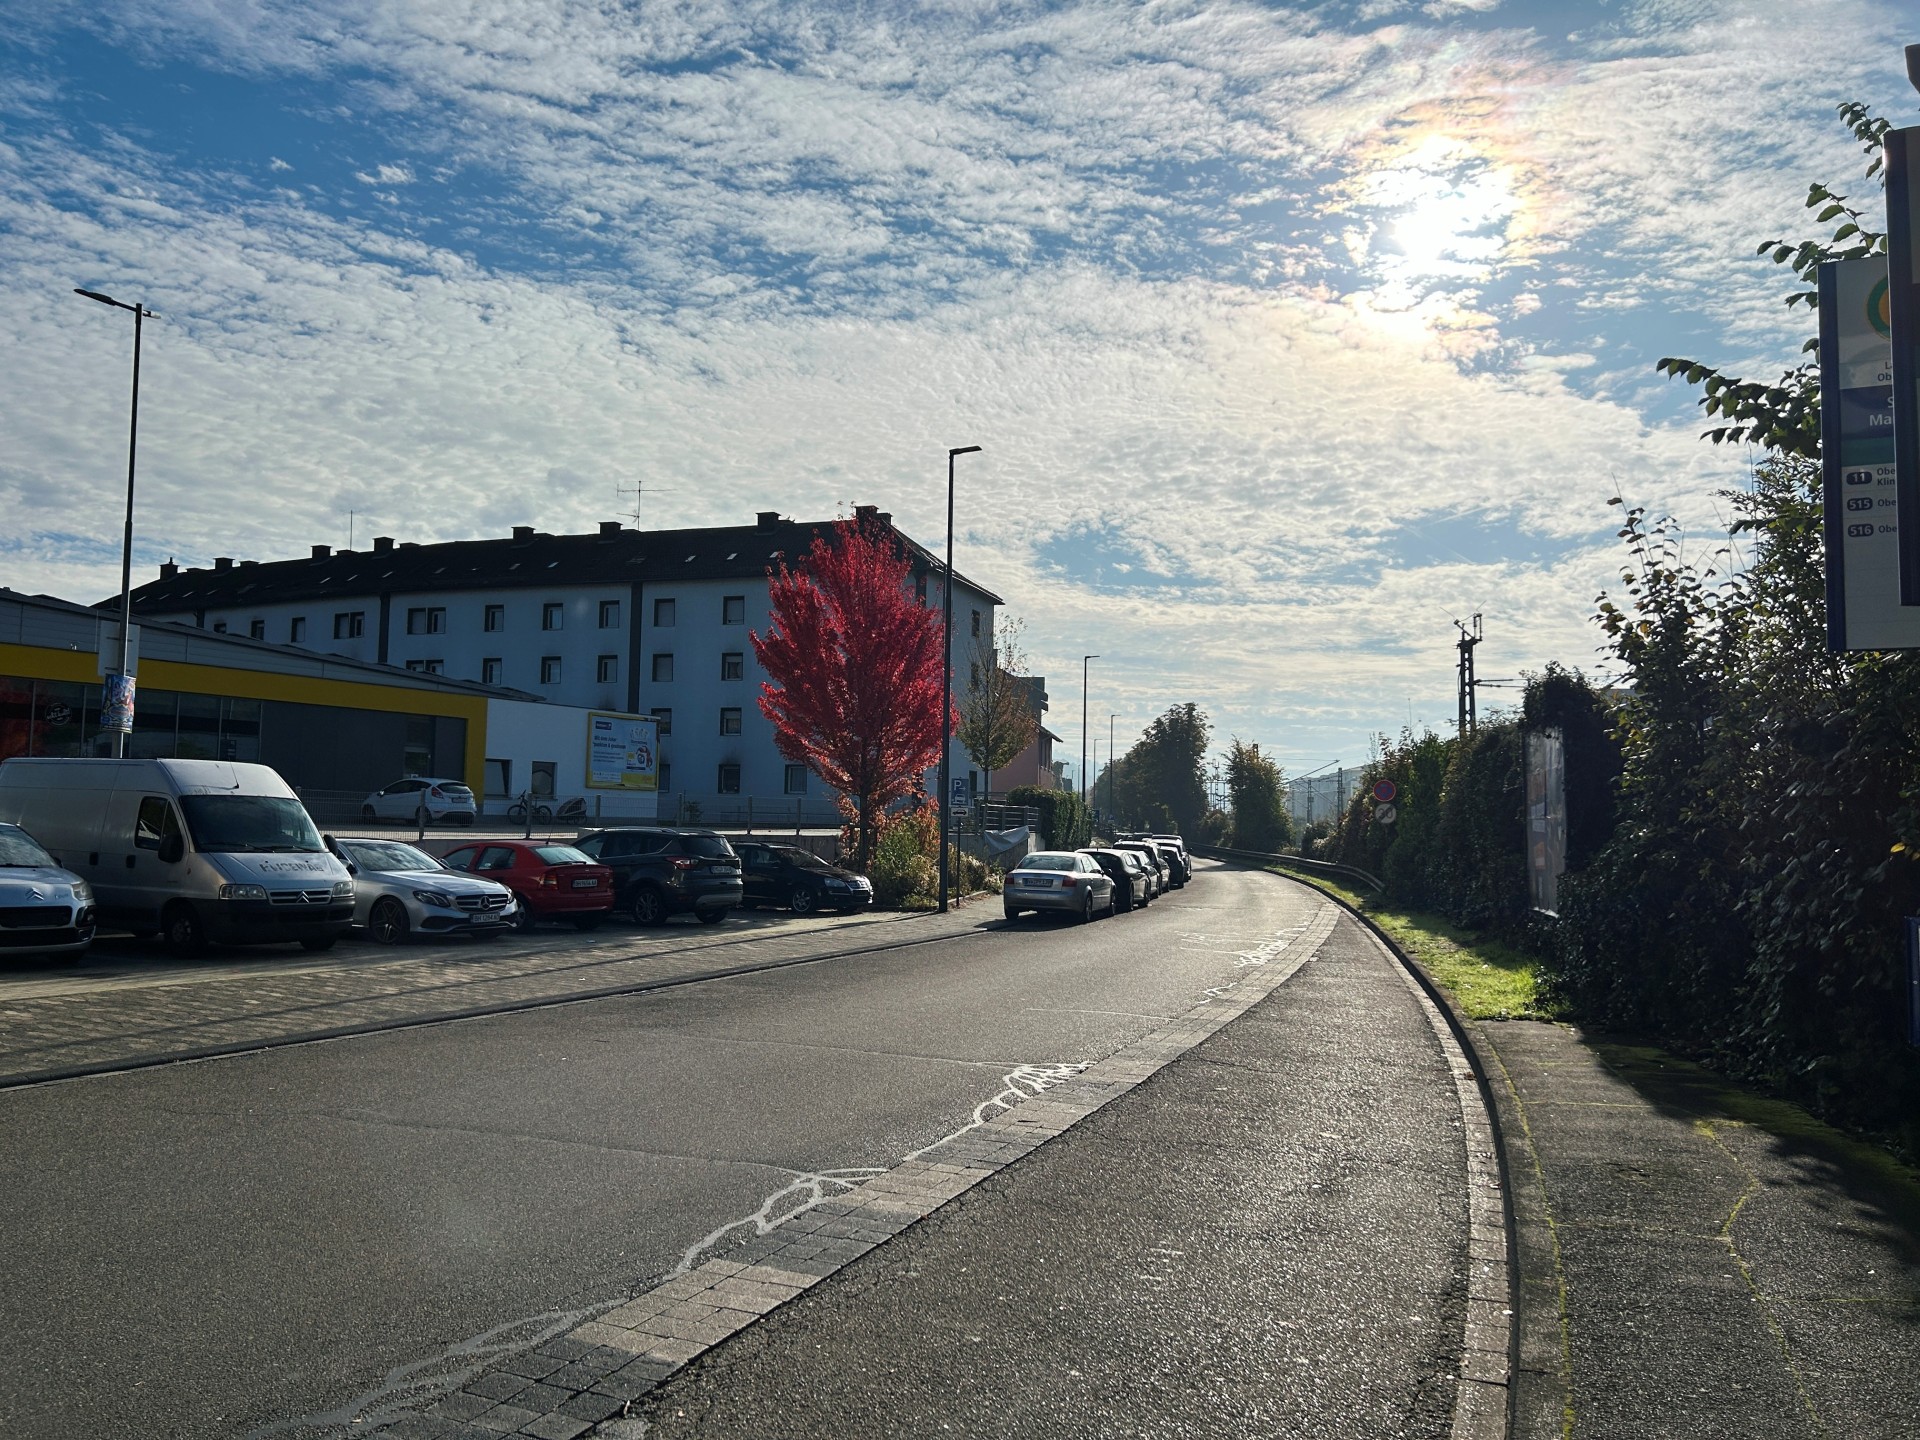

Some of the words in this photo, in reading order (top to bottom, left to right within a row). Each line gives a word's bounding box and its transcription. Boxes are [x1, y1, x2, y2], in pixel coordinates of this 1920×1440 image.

[1854, 473, 1865, 483] 11
[1849, 499, 1871, 510] 515
[1850, 525, 1872, 536] 516
[954, 780, 962, 791] P
[1378, 807, 1394, 819] 30
